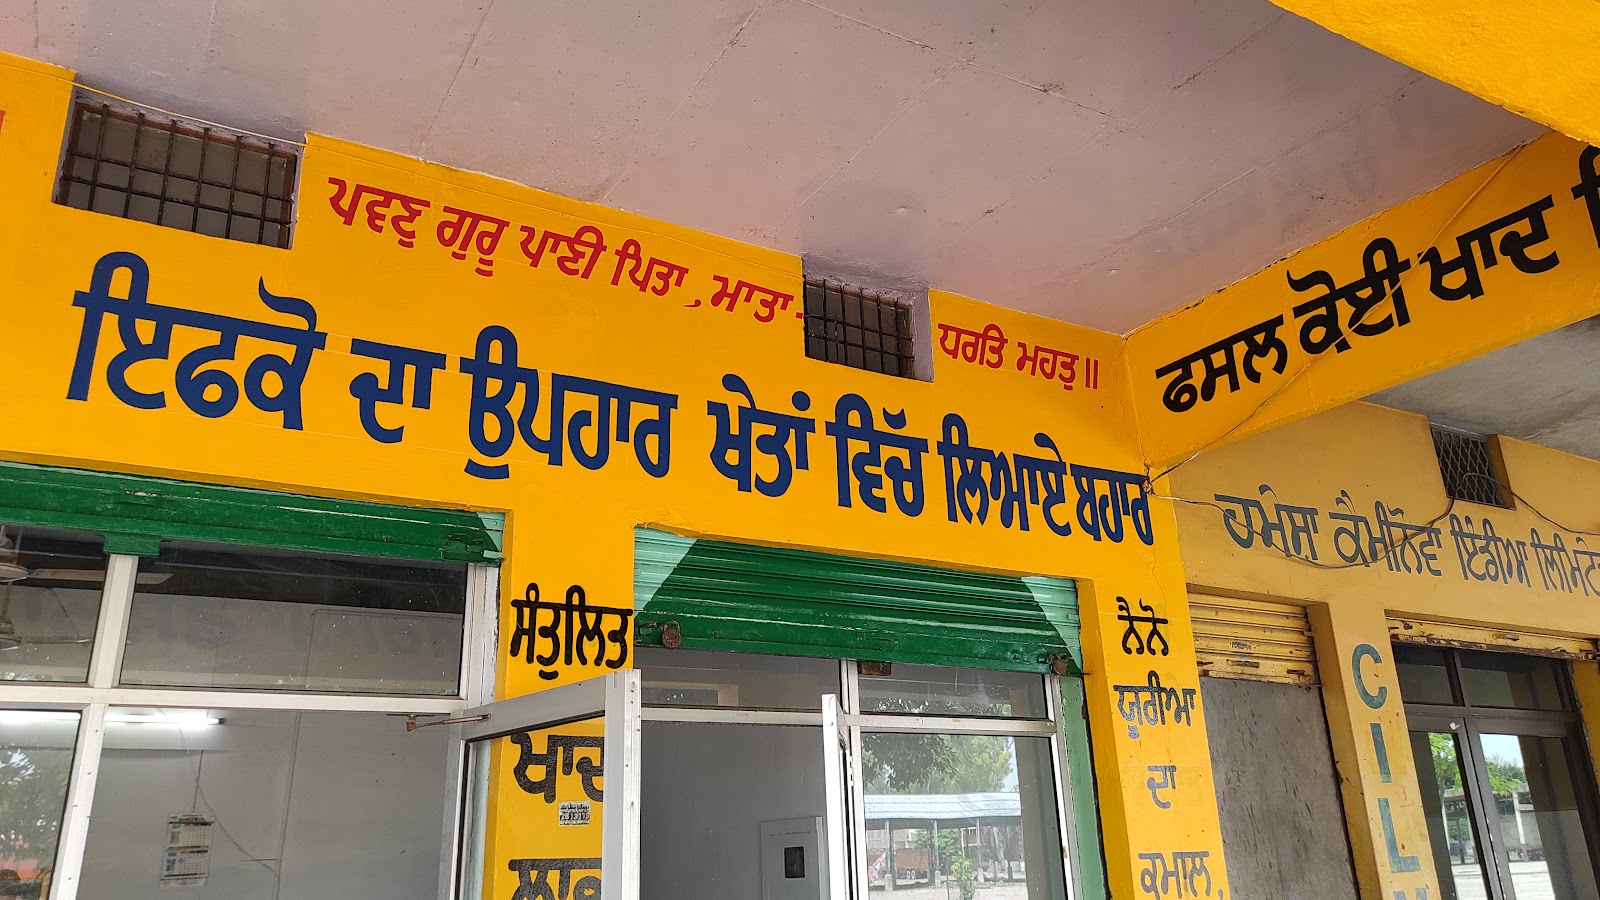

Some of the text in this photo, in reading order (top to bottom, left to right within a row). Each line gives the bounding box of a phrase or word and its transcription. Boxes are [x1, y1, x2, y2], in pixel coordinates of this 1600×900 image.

[328, 176, 431, 249] ਪਵਣੁ
[436, 205, 511, 277] ਗੁਰੂ
[519, 225, 608, 280] ਪਾਣੀ
[937, 323, 1009, 369] ਧਰਤਿ
[1155, 314, 1289, 414] ਫਸਲ
[1286, 237, 1417, 356] ਕੋਈ
[1417, 193, 1561, 302] ਖਾਦ
[66, 251, 1154, 546] ਇਫਕੋ ਦਾ ਉਪਹਾਰ ਖੇਤਾਂ ਵਿੱਚ ਲਿਆਏ ਬਹਾਰ
[1449, 513, 1532, 588] ਇੰਡੀਆ
[509, 582, 634, 681] ਸੰਤੁਲਿਤ
[1116, 595, 1169, 656] ਨੈਨੋ
[1113, 670, 1197, 740] ਯੂਰੀਆ
[1146, 765, 1177, 809] ਦਾ
[1351, 643, 1428, 900] CIL
